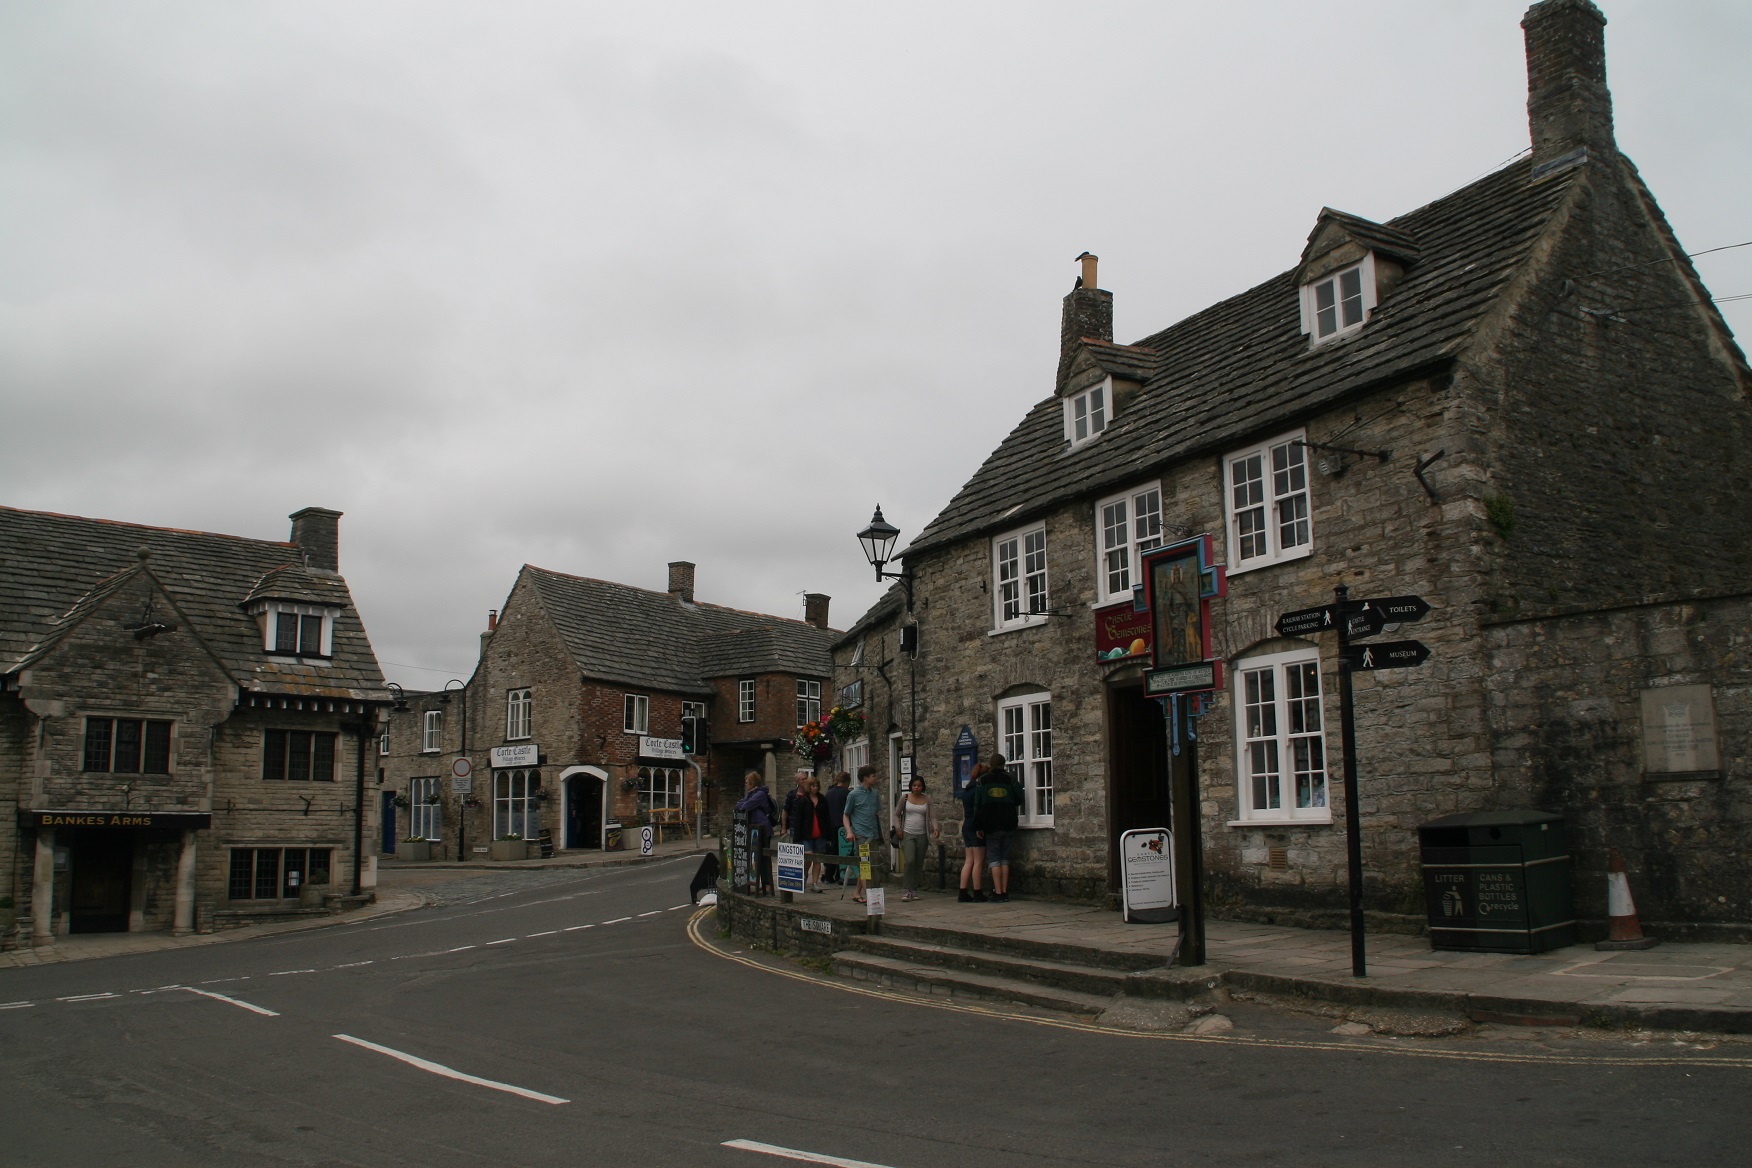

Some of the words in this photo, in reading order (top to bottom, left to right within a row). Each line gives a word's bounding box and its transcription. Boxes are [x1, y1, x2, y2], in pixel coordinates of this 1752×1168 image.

[1389, 605, 1417, 613] TOILETS
[1282, 616, 1300, 624] RAILWAY
[1301, 612, 1320, 620] STATION
[1282, 624, 1298, 633] CYCLE
[1298, 622, 1319, 630] PARKING
[1389, 650, 1417, 658] MUSEUM
[645, 738, 662, 748] Corfe
[497, 747, 511, 757] Corfe
[513, 745, 532, 755] Castle
[42, 815, 105, 826] BANKES
[110, 815, 152, 826] ARMS
[779, 845, 804, 856] KINGSTON
[778, 857, 794, 866] COUNTRY
[795, 859, 804, 867] FAIR
[1128, 854, 1168, 862] GEMSTONES
[1434, 874, 1465, 883] LITTER
[1480, 873, 1503, 882] CANS
[1479, 883, 1515, 891] PLASTIC
[1478, 892, 1517, 901] BOTTLES
[1490, 902, 1519, 912] recycle
[802, 919, 811, 929] THE
[812, 920, 831, 933] SQUARE
